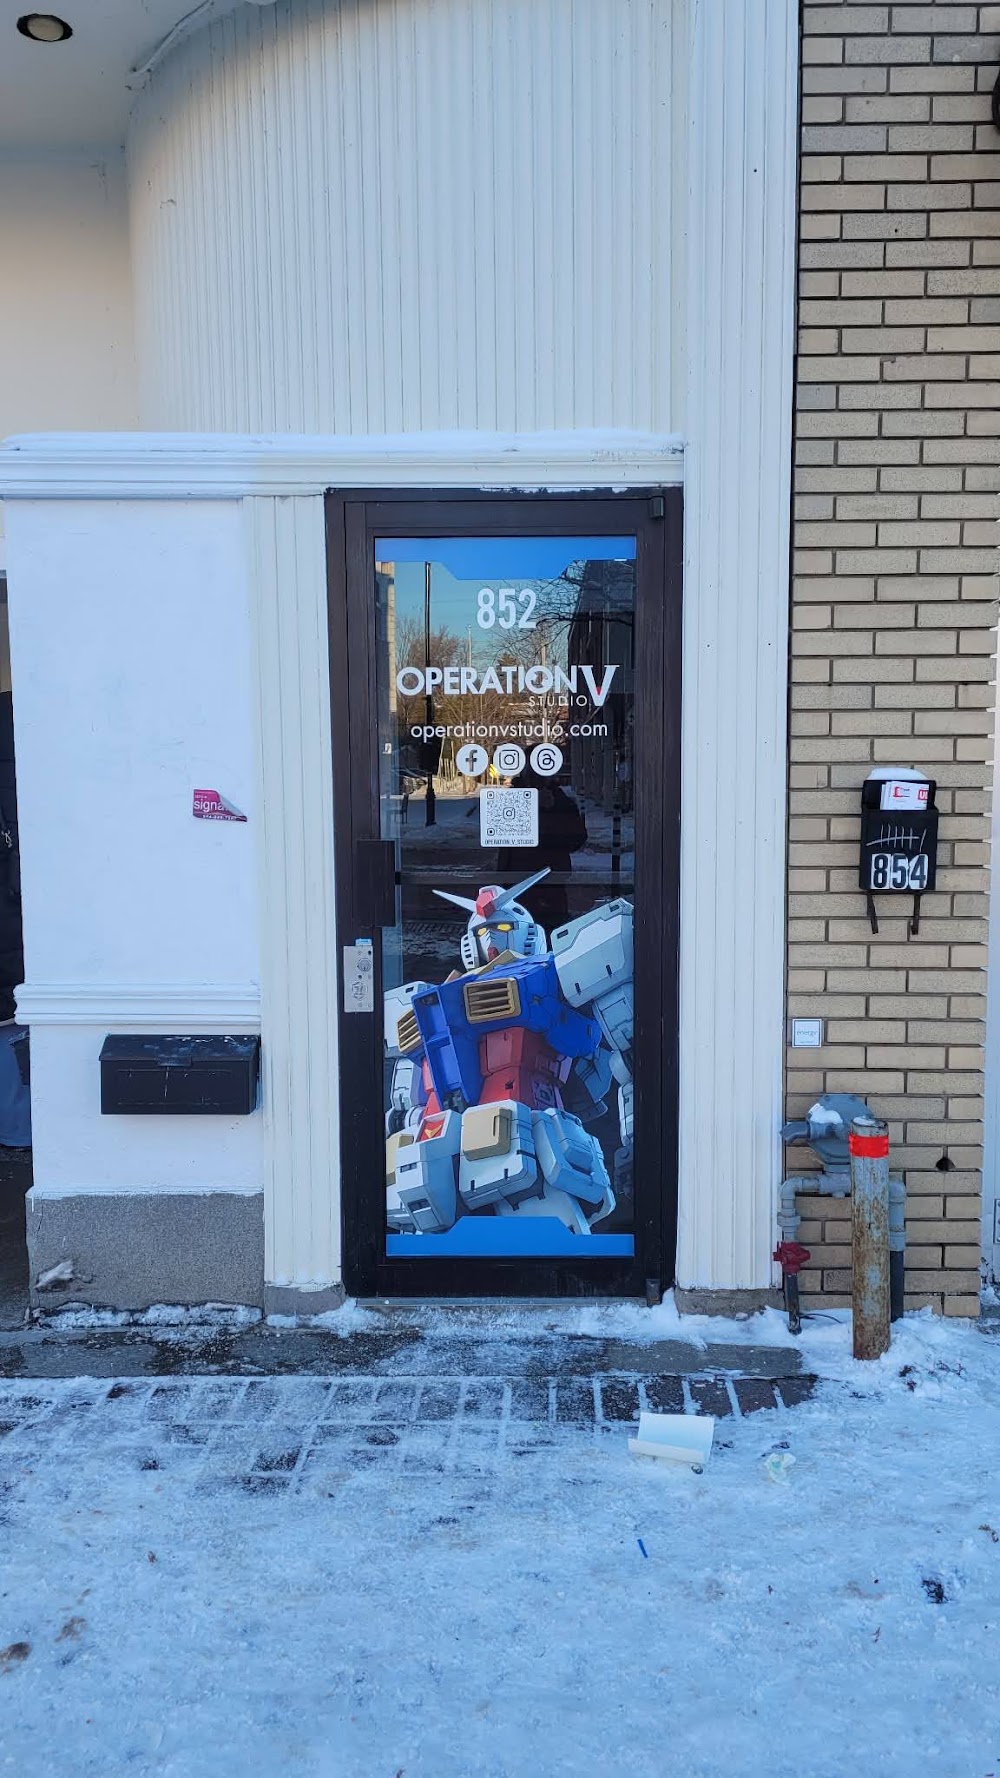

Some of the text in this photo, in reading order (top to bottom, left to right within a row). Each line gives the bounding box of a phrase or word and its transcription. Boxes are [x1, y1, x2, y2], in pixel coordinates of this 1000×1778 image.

[476, 588, 538, 629] 852
[528, 695, 588, 707] STUDIO
[410, 718, 608, 743] operationvstudio.com
[873, 854, 927, 889] 854
